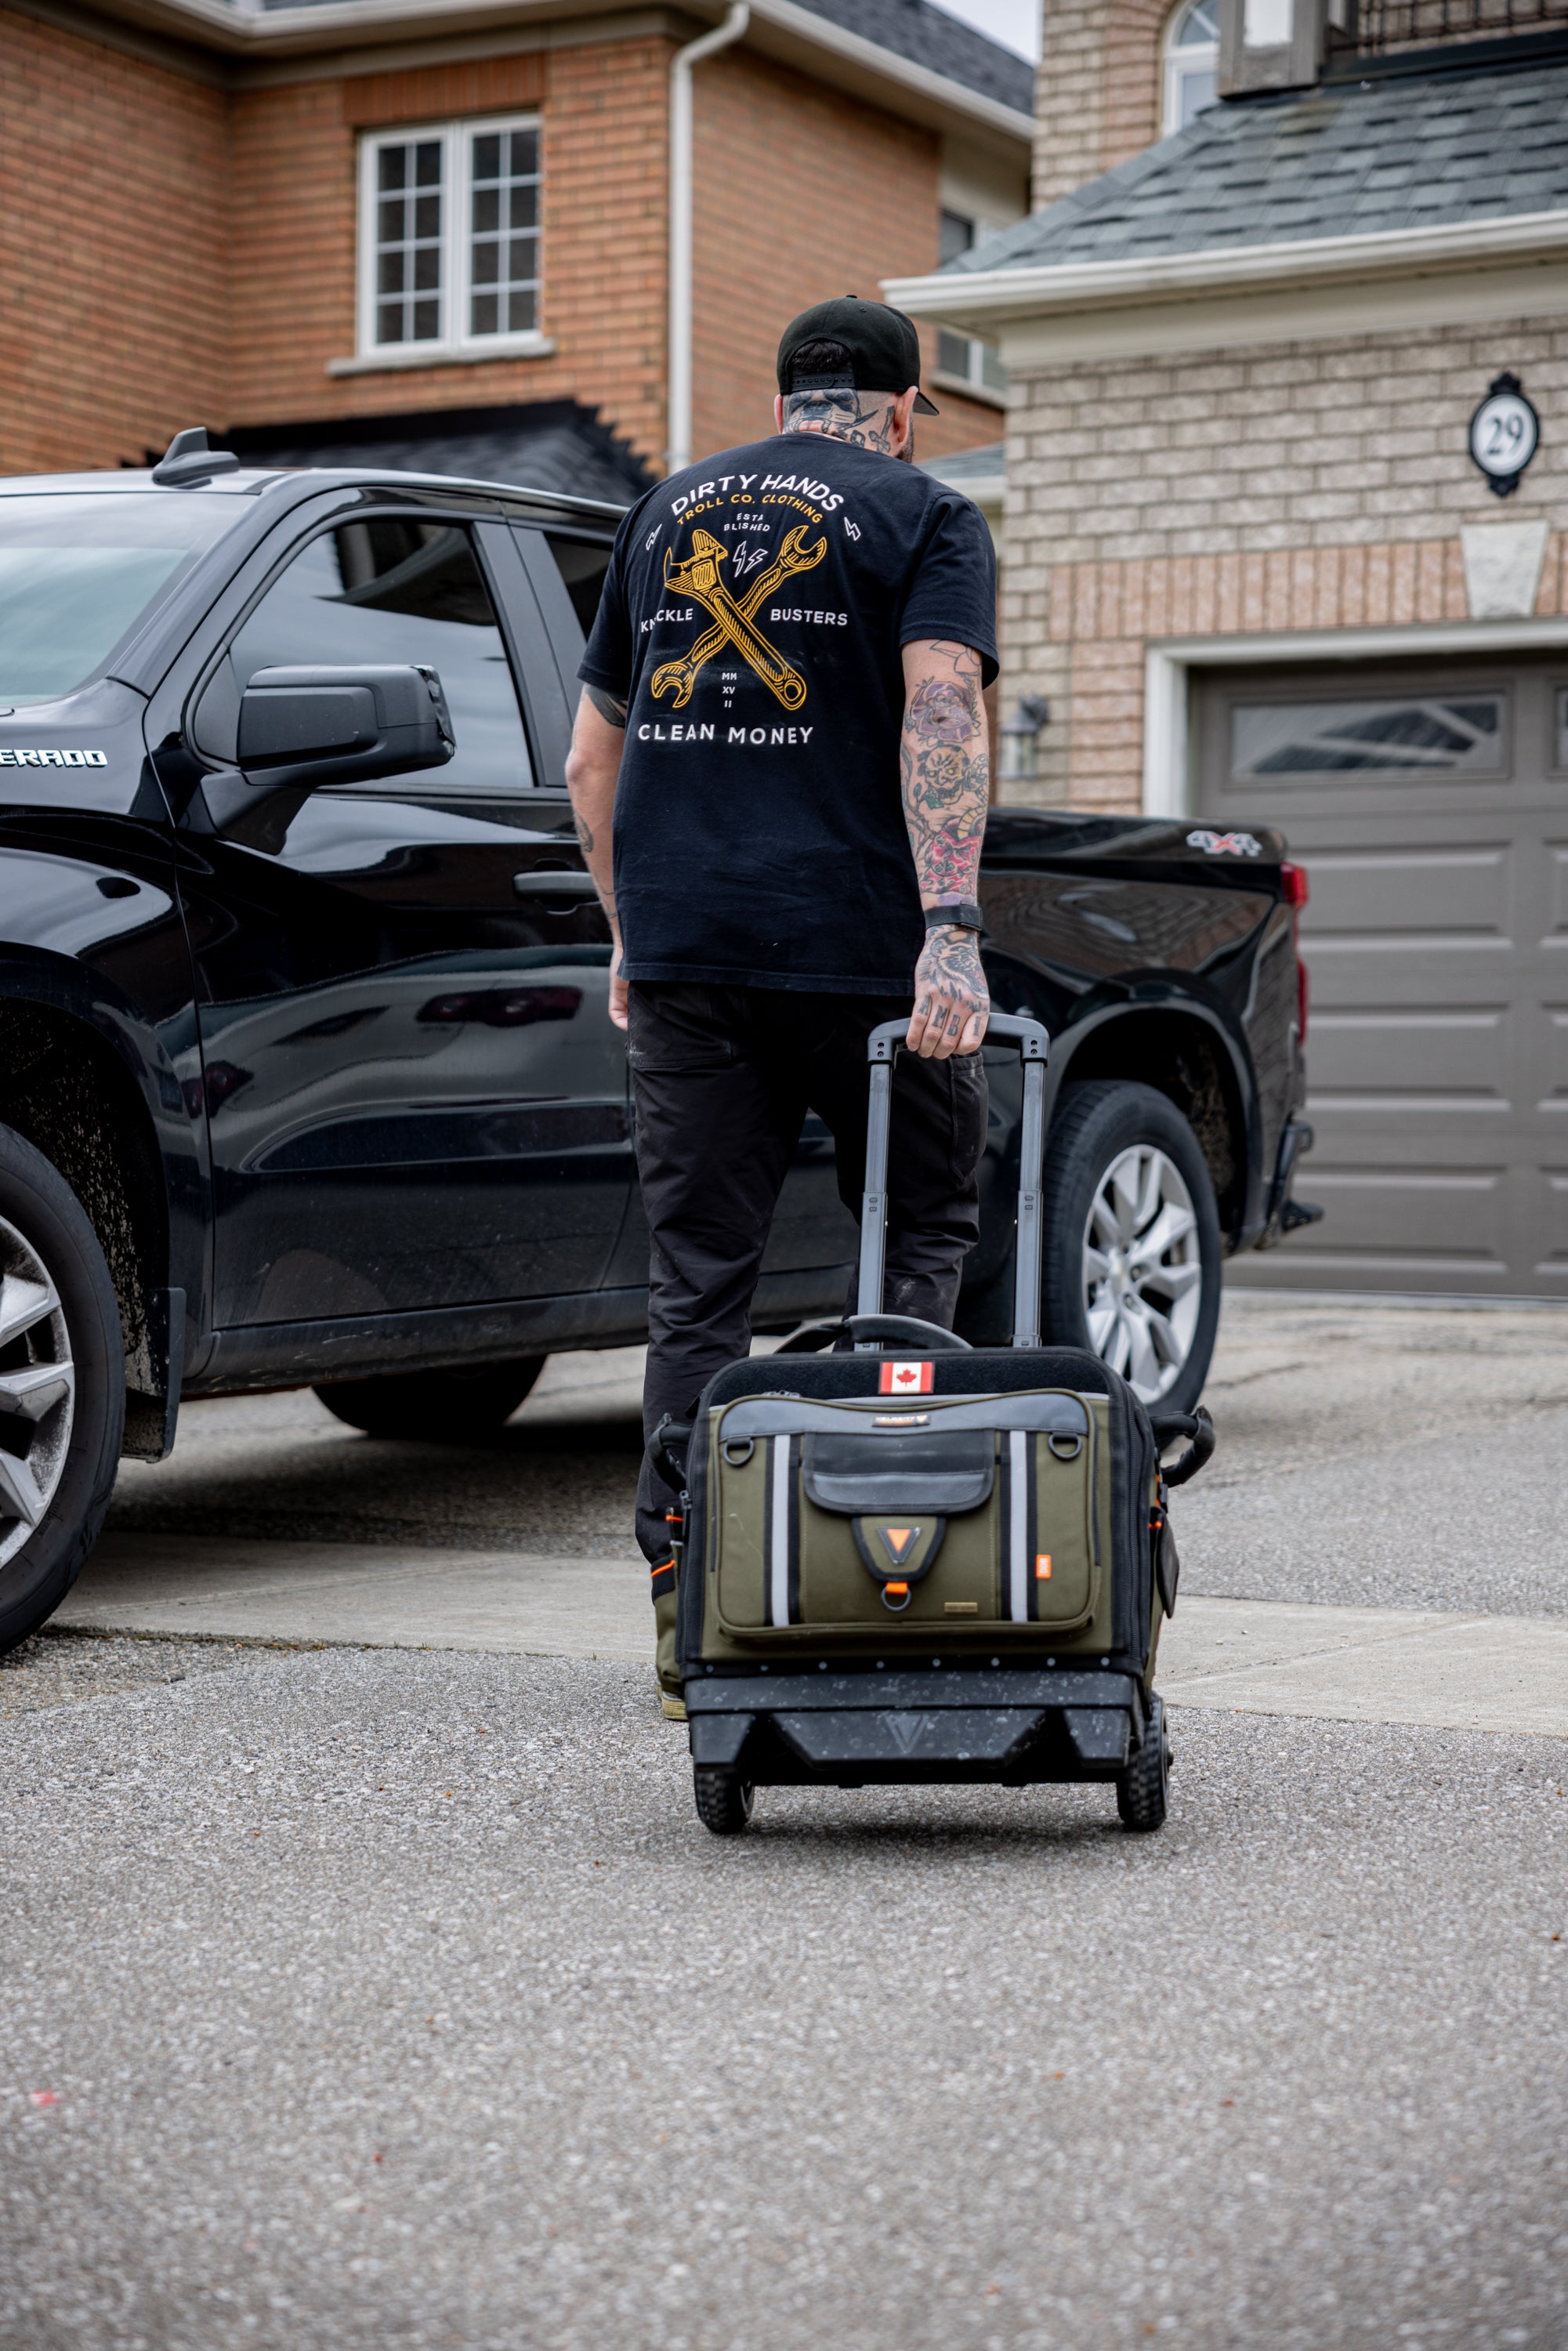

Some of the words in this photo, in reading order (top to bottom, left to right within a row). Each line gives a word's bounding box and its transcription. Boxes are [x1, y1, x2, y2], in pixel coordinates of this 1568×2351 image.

[1487, 414, 1523, 456] 29
[671, 473, 758, 516] DIRTY
[759, 474, 845, 512] HANDS
[676, 497, 724, 525] TROLL
[730, 494, 755, 504] CO.
[762, 494, 823, 523] CLOTHING
[736, 513, 764, 522] ESTA
[723, 522, 770, 532] BLISHED
[640, 607, 693, 632] KNCKLE
[770, 608, 848, 626] BUSTERS
[722, 672, 737, 680] MM
[722, 686, 736, 694] XV
[638, 723, 715, 741] CLEAN
[727, 726, 813, 744] MONEY
[0, 749, 107, 767] ERADO
